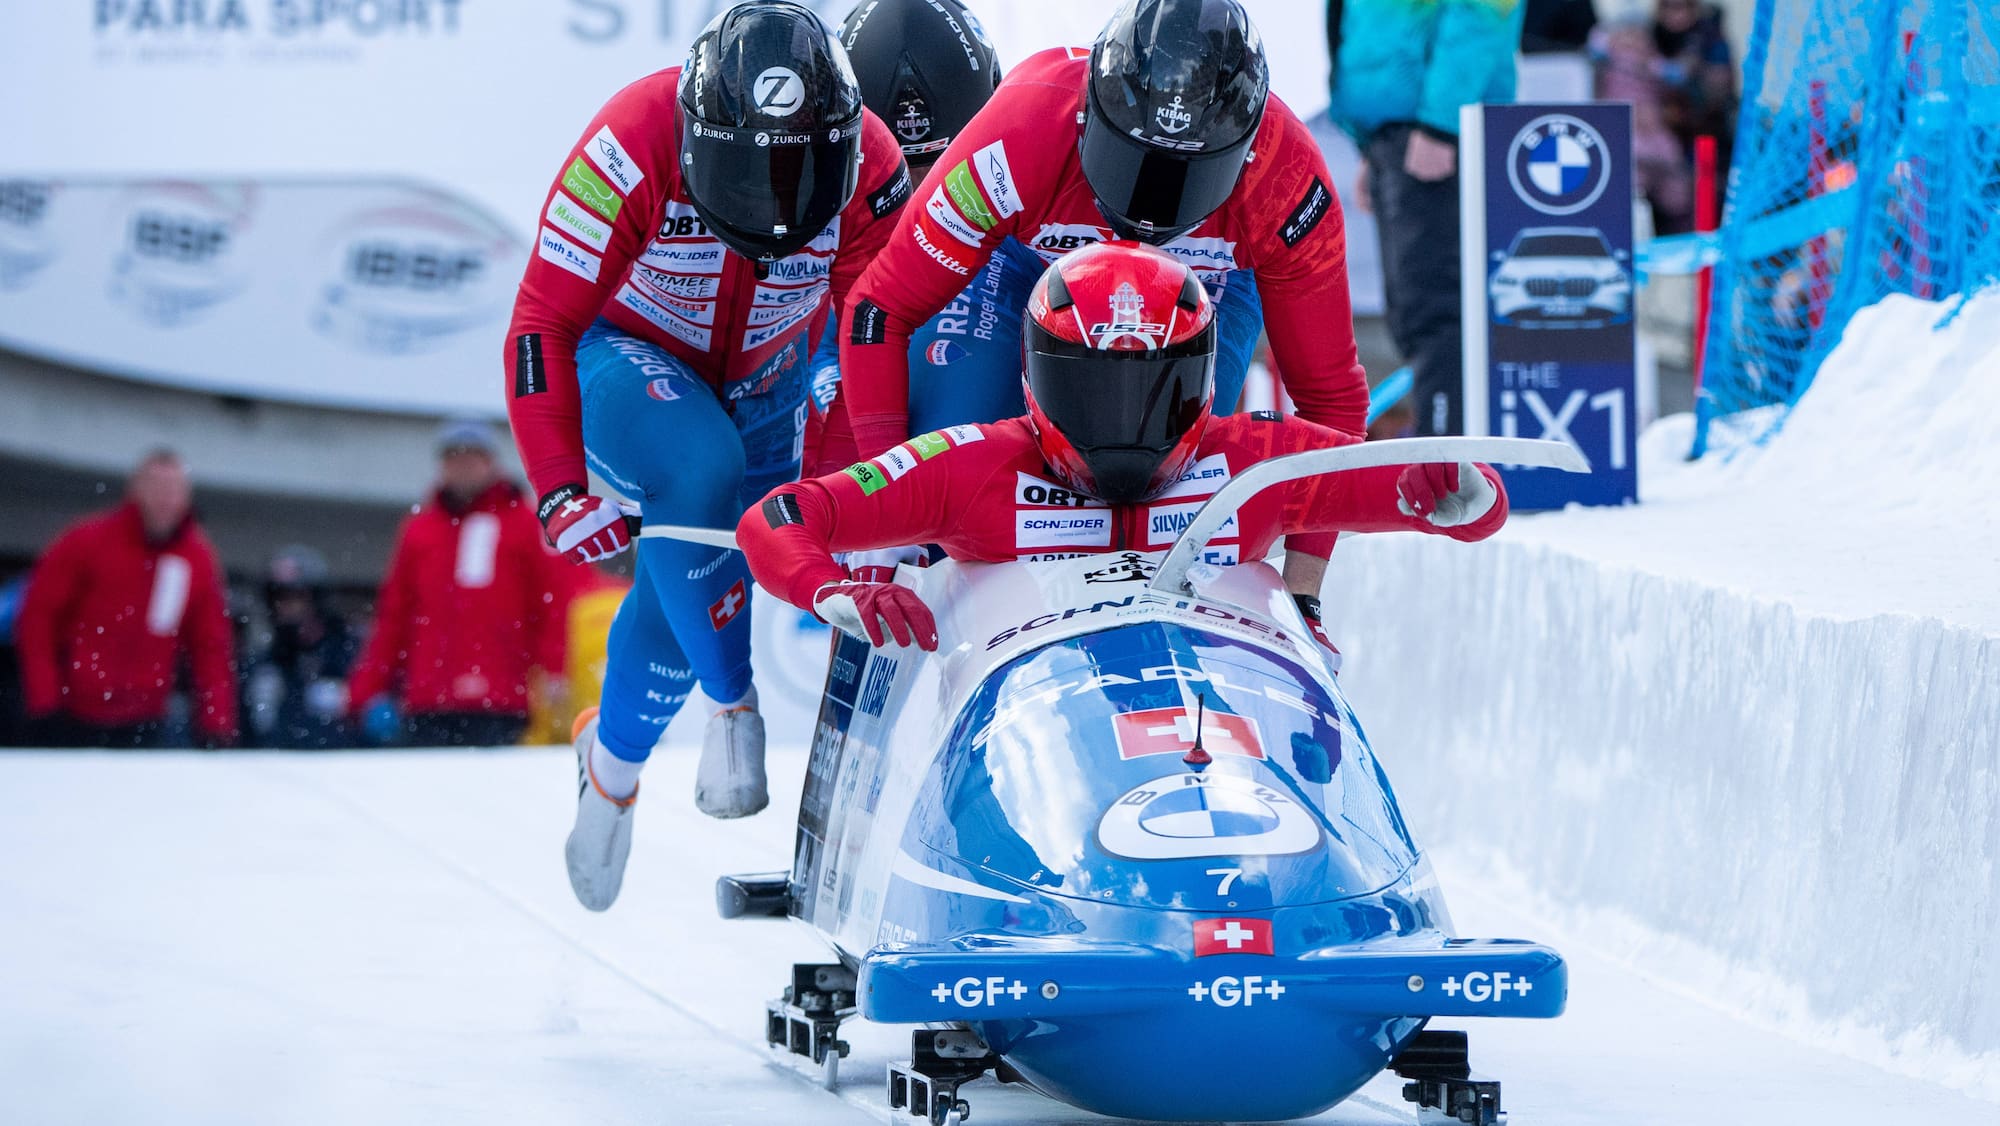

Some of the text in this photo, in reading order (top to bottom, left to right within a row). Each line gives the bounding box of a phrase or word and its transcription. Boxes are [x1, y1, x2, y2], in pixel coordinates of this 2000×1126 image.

[896, 118, 930, 128] KIBAG
[1156, 106, 1192, 123] KIBAG
[702, 127, 734, 141] ZURICH
[772, 134, 811, 145] ZURICH
[1129, 127, 1206, 152] LS2
[606, 147, 625, 169] Optik
[567, 177, 584, 195] pro
[608, 162, 630, 188] Bruhin
[995, 171, 1009, 197] Optik
[948, 182, 964, 203] pro
[1285, 184, 1324, 238] LS2
[660, 215, 707, 238] OBT
[542, 235, 565, 255] linth
[1039, 234, 1100, 249] OBT
[646, 247, 719, 261] SCHNEIDER
[640, 267, 713, 287] ARMEE
[1108, 294, 1145, 304] KIBAG
[973, 296, 998, 341] Roger
[1089, 322, 1167, 337] LS2
[1497, 362, 1561, 389] THE
[1500, 388, 1627, 470] iX1
[1022, 485, 1089, 508] OBT
[1023, 518, 1105, 530] SCHNEIDER
[1119, 774, 1290, 807] BMW
[1206, 868, 1243, 896] 7
[931, 976, 1028, 1008] +GF+
[1187, 975, 1286, 1008] +GF+
[1441, 970, 1534, 1004] +GF+
